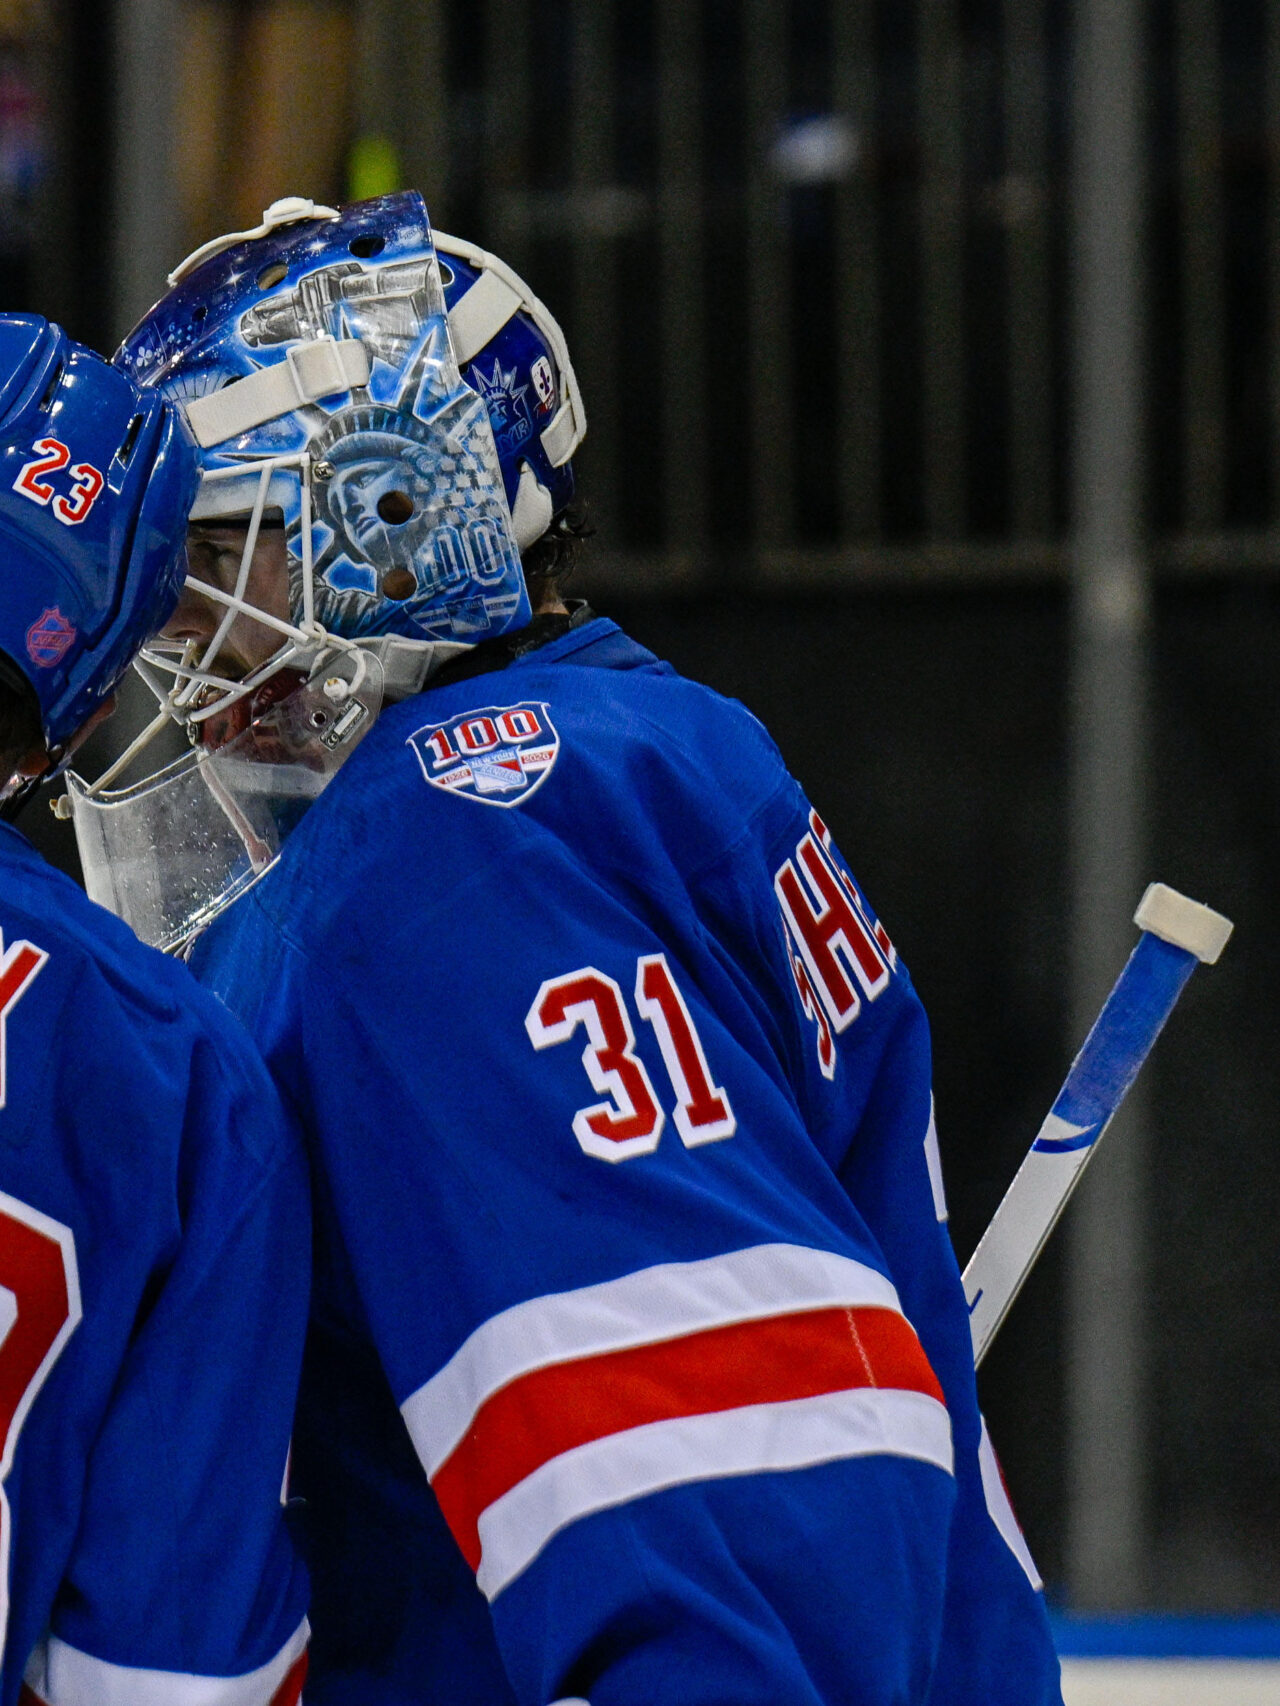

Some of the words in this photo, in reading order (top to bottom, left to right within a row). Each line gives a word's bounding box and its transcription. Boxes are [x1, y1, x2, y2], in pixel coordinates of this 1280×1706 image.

[12, 437, 104, 526] 23
[424, 709, 543, 770] 100
[524, 953, 738, 1164] 31
